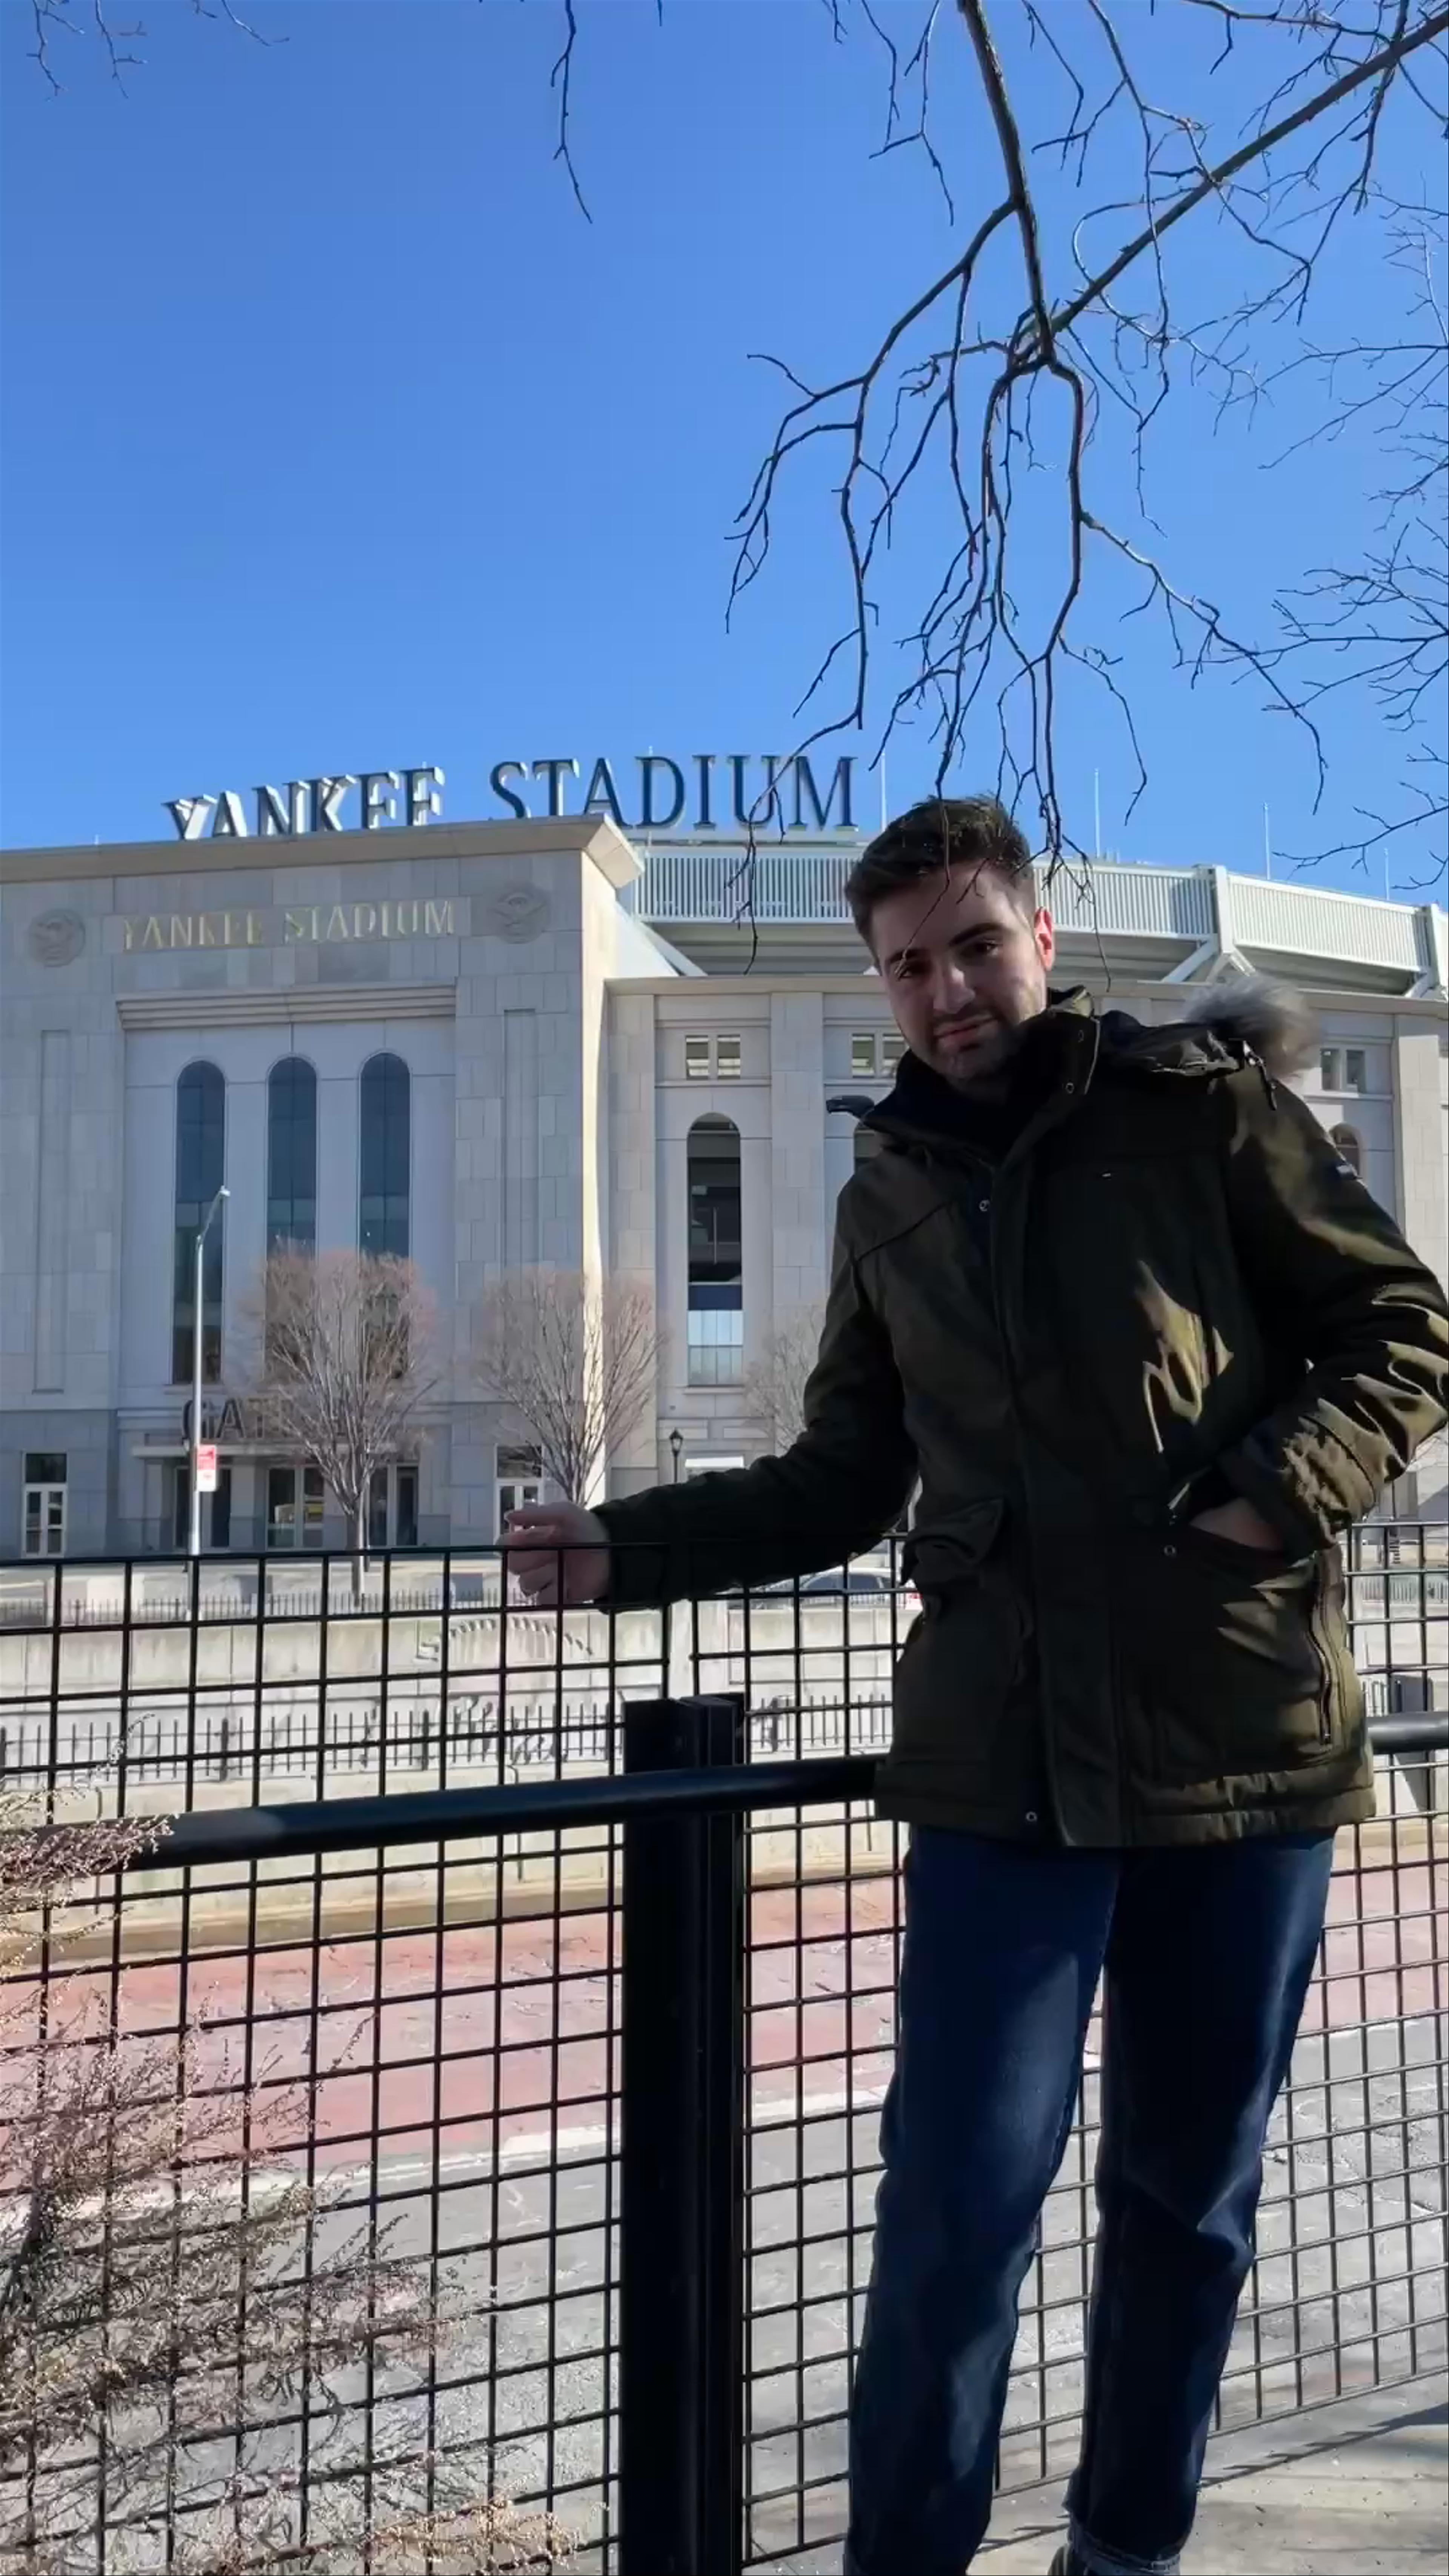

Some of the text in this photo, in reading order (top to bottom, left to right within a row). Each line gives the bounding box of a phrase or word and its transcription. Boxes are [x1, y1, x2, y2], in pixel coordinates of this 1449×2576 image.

[161, 754, 858, 840] YANKEE STADIUM
[124, 901, 454, 950] YANKEE STADIUM
